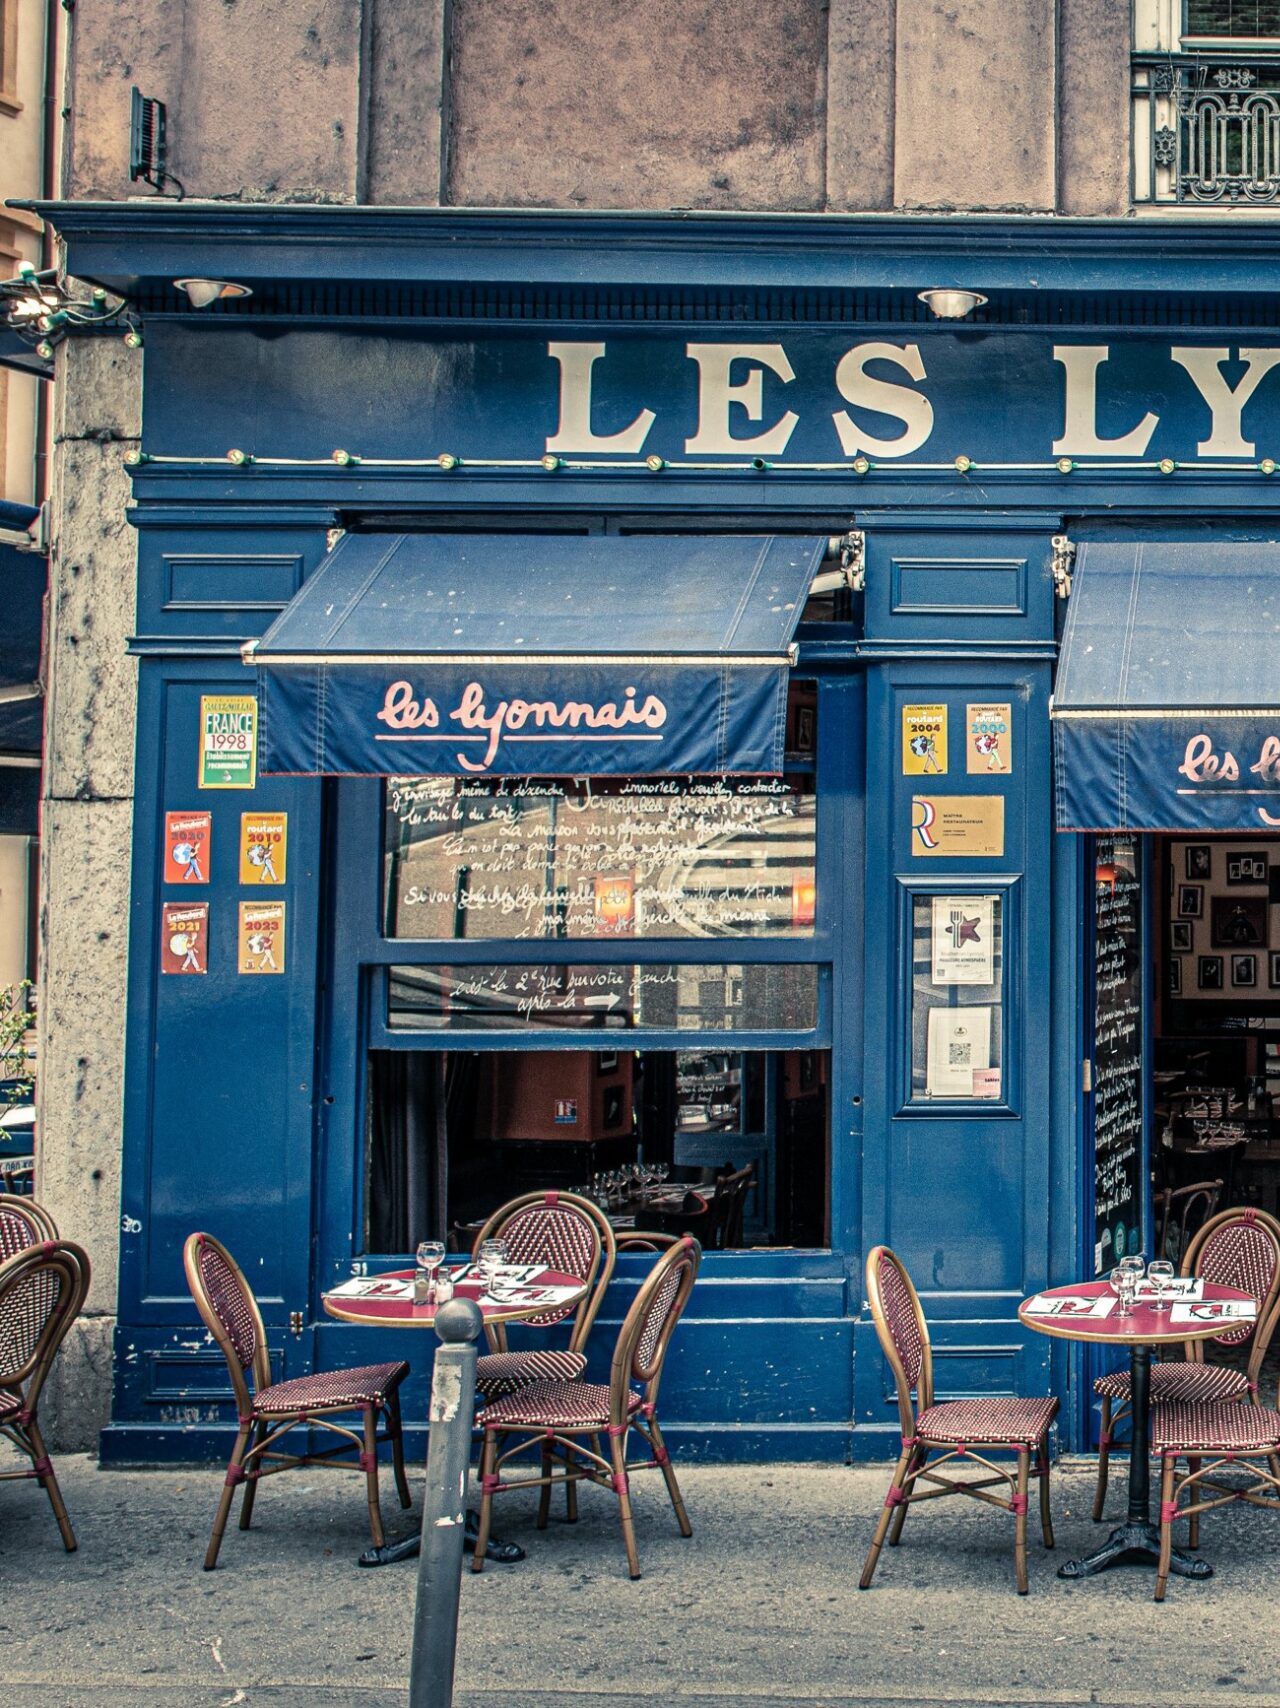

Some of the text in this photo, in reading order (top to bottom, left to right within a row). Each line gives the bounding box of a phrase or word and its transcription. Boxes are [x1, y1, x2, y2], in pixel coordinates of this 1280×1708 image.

[546, 341, 933, 458] LES
[206, 713, 252, 734] FRANCE
[377, 681, 667, 771] les lyonnais
[906, 715, 943, 723] routard
[211, 734, 247, 750] 1998
[1178, 734, 1239, 782] les
[247, 824, 283, 833] routard
[248, 833, 281, 842] 2010
[169, 922, 200, 931] 2021
[245, 921, 279, 931] 2023
[350, 1262, 368, 1277] 31
